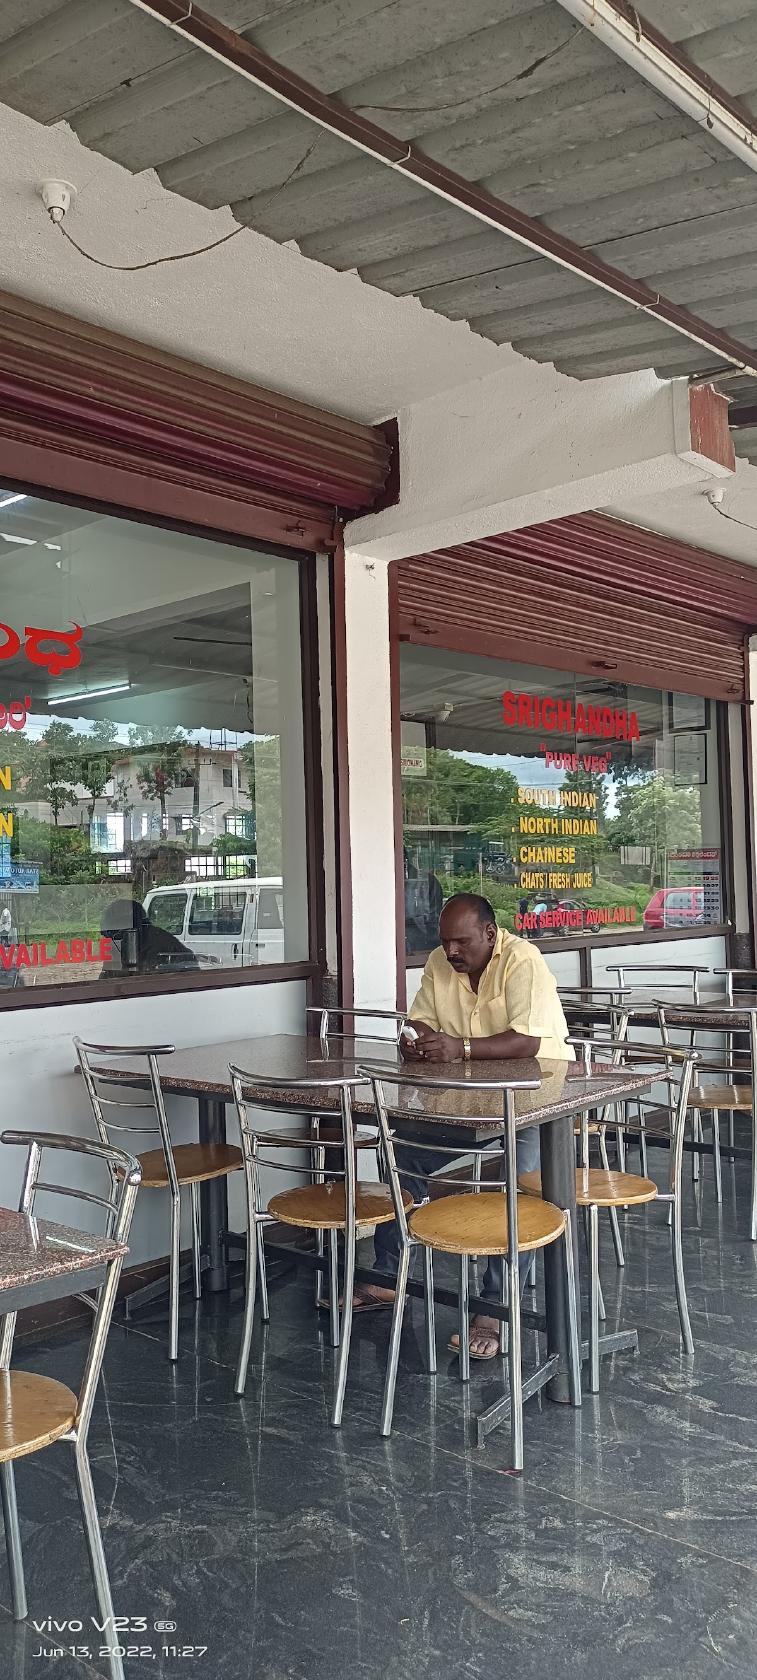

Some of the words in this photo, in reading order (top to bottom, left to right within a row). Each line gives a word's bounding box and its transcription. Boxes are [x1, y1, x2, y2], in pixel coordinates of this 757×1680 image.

[503, 691, 640, 741] SRIGHANDHA
[518, 787, 557, 804] SOUTH
[560, 790, 597, 808] INDIAN
[520, 817, 558, 834] NORTH
[561, 818, 598, 835] INDIAN
[520, 846, 576, 863] CHAINESE
[520, 872, 544, 888] CHATS
[548, 872, 571, 888] FRESH
[572, 872, 593, 888] JUICE
[514, 912, 537, 931] CAR
[539, 910, 583, 928] SERVICE
[586, 906, 636, 924] AVAILABLE
